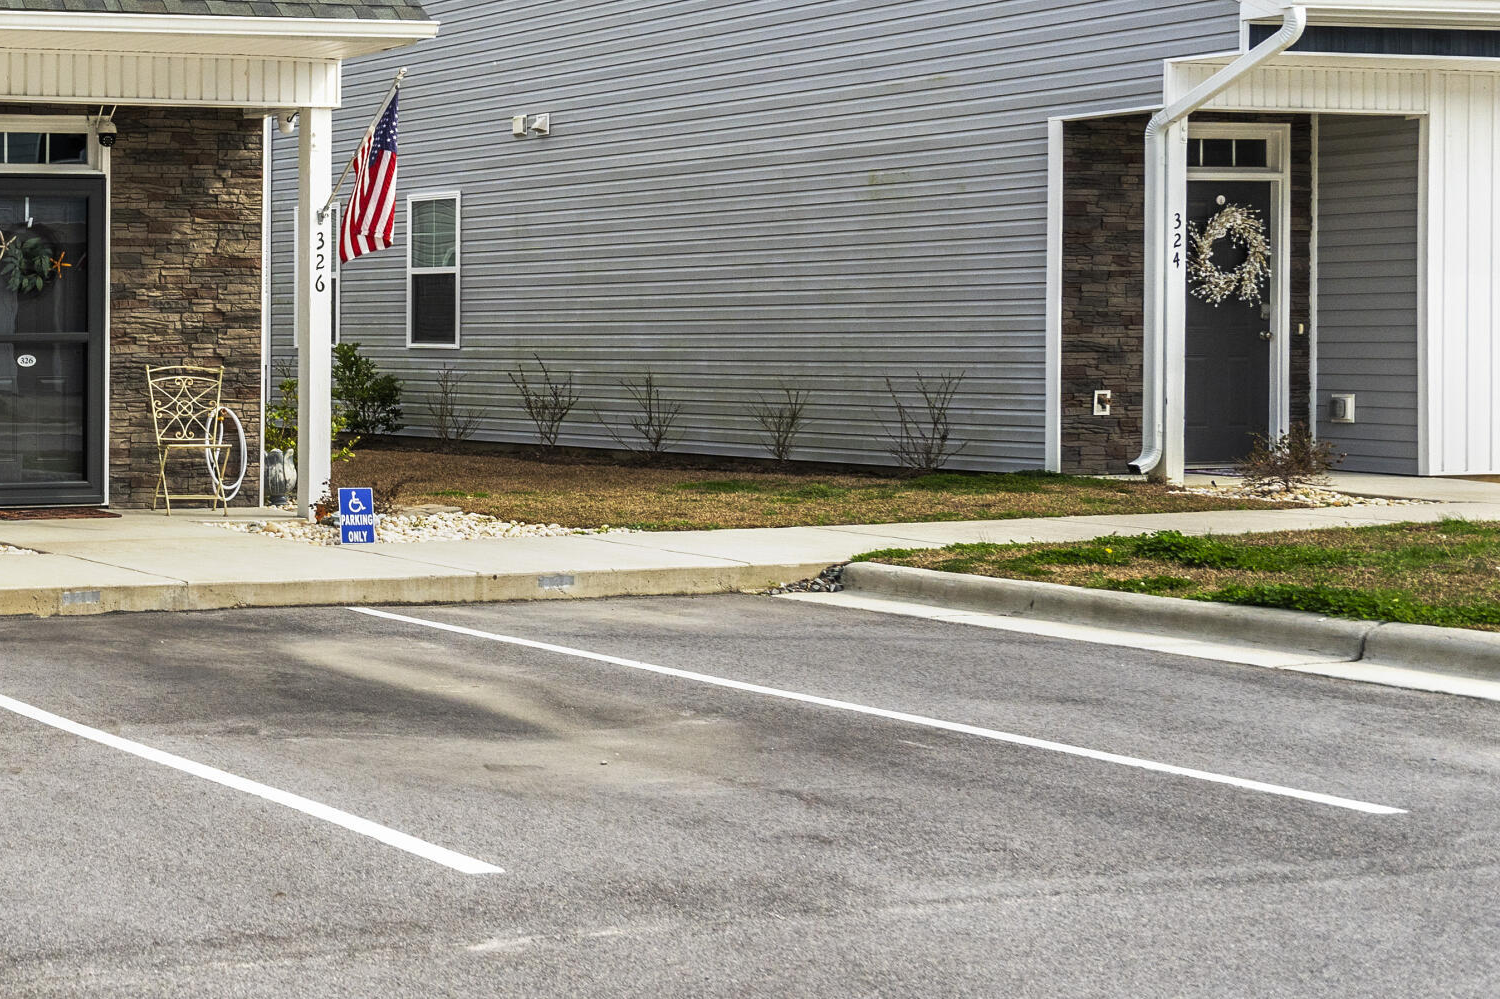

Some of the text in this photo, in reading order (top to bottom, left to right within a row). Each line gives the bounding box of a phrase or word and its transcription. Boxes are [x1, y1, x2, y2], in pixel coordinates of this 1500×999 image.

[1173, 212, 1182, 269] 324
[315, 231, 325, 293] 326
[20, 357, 34, 365] 326
[341, 514, 373, 526] PARKING
[348, 530, 368, 543] ONLY
